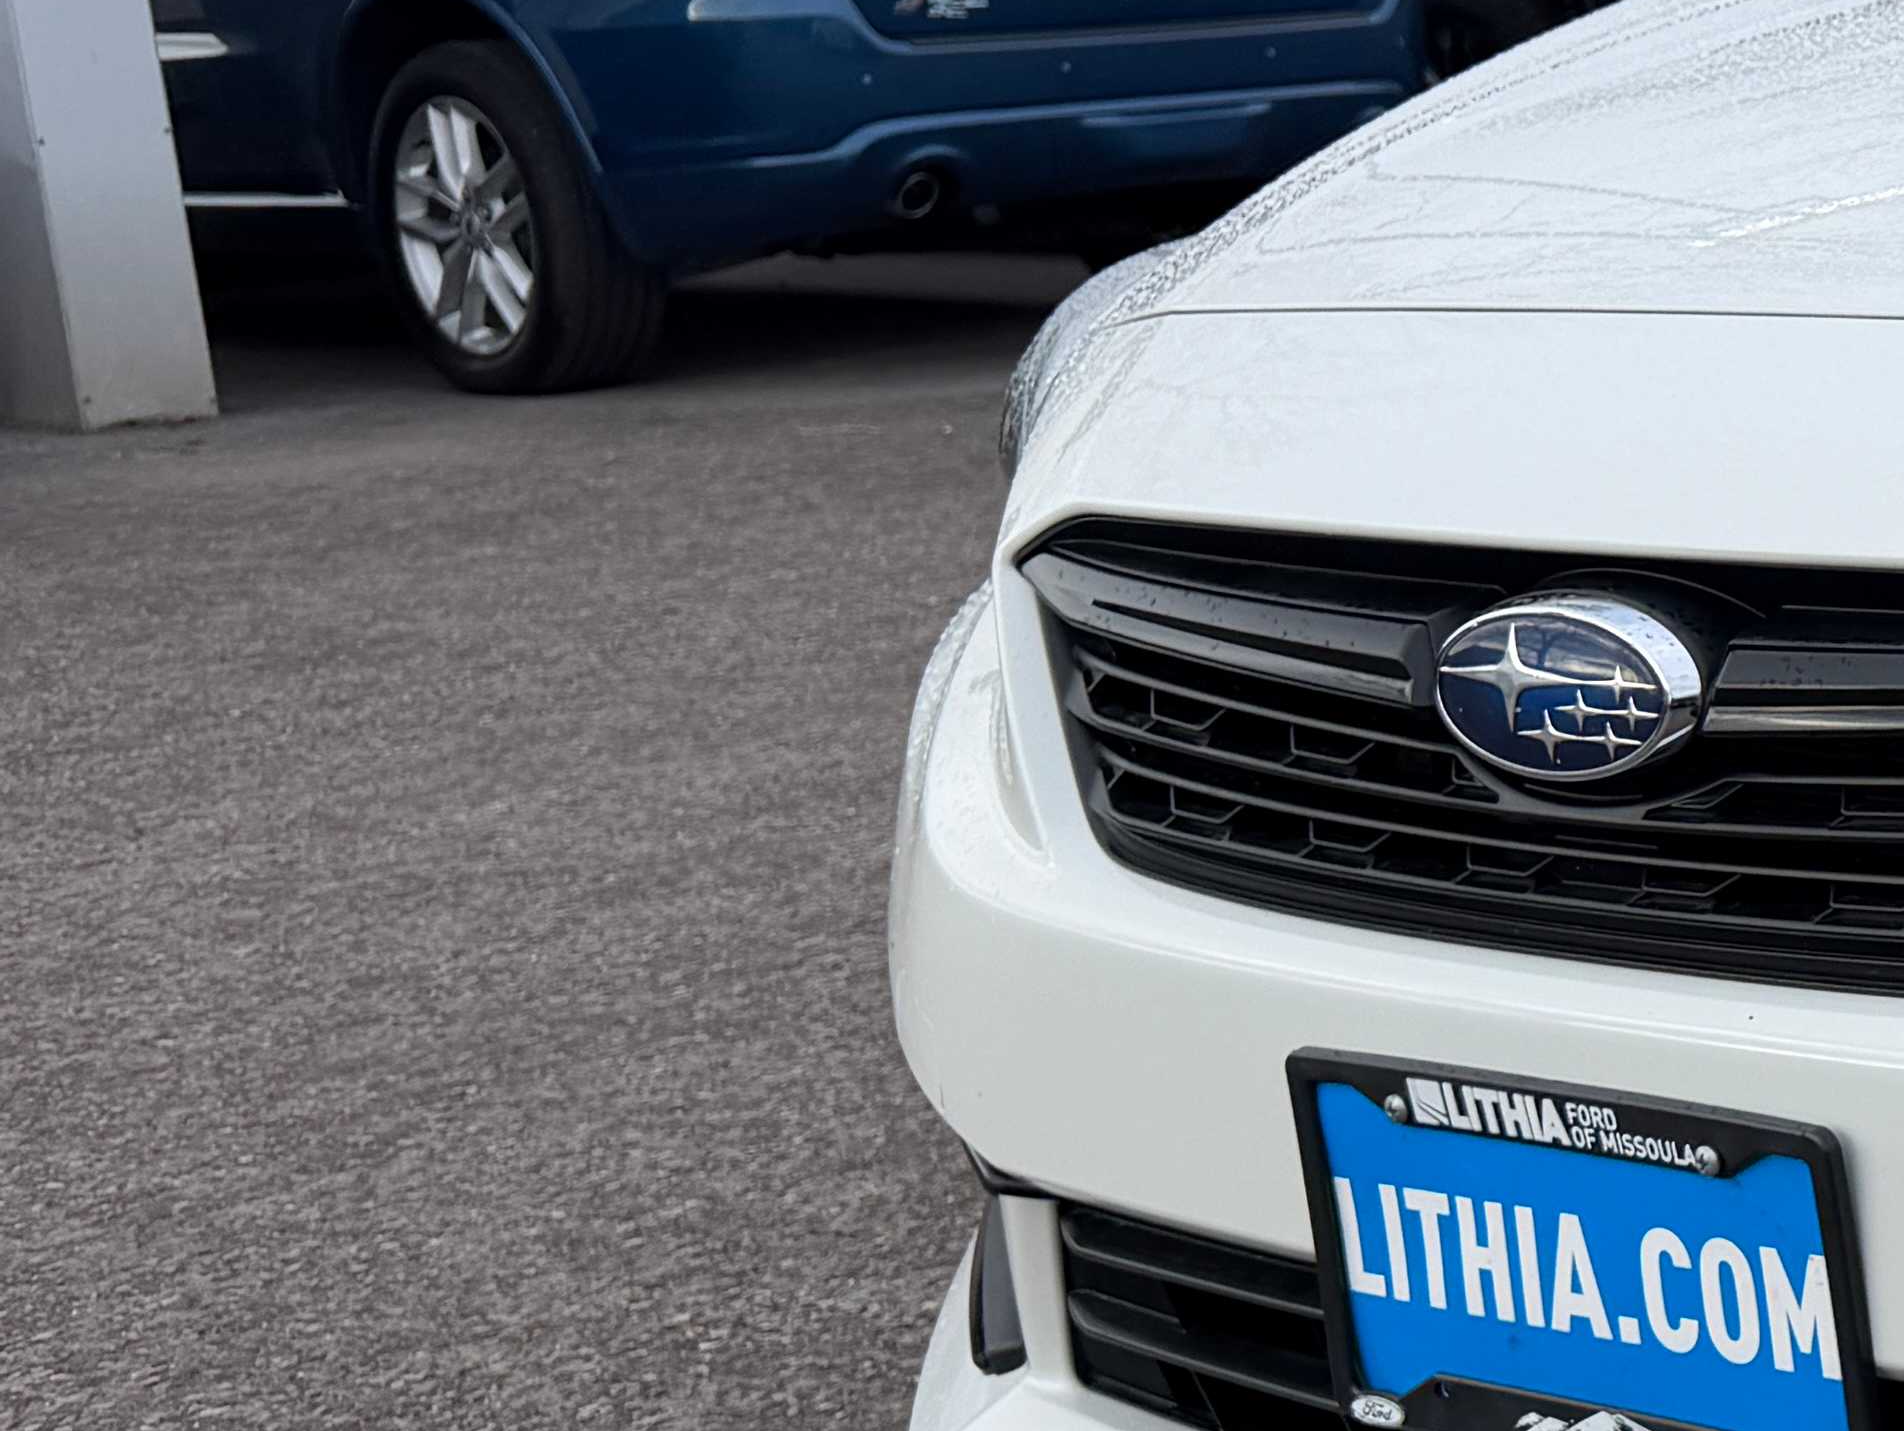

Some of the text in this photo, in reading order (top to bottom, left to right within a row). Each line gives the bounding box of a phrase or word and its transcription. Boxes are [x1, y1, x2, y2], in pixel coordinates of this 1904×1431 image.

[1441, 1081, 1617, 1146] LITHIA FORD
[1569, 1126, 1697, 1168] OF MISSOULA
[1334, 1175, 1843, 1381] LITHIA.COM
